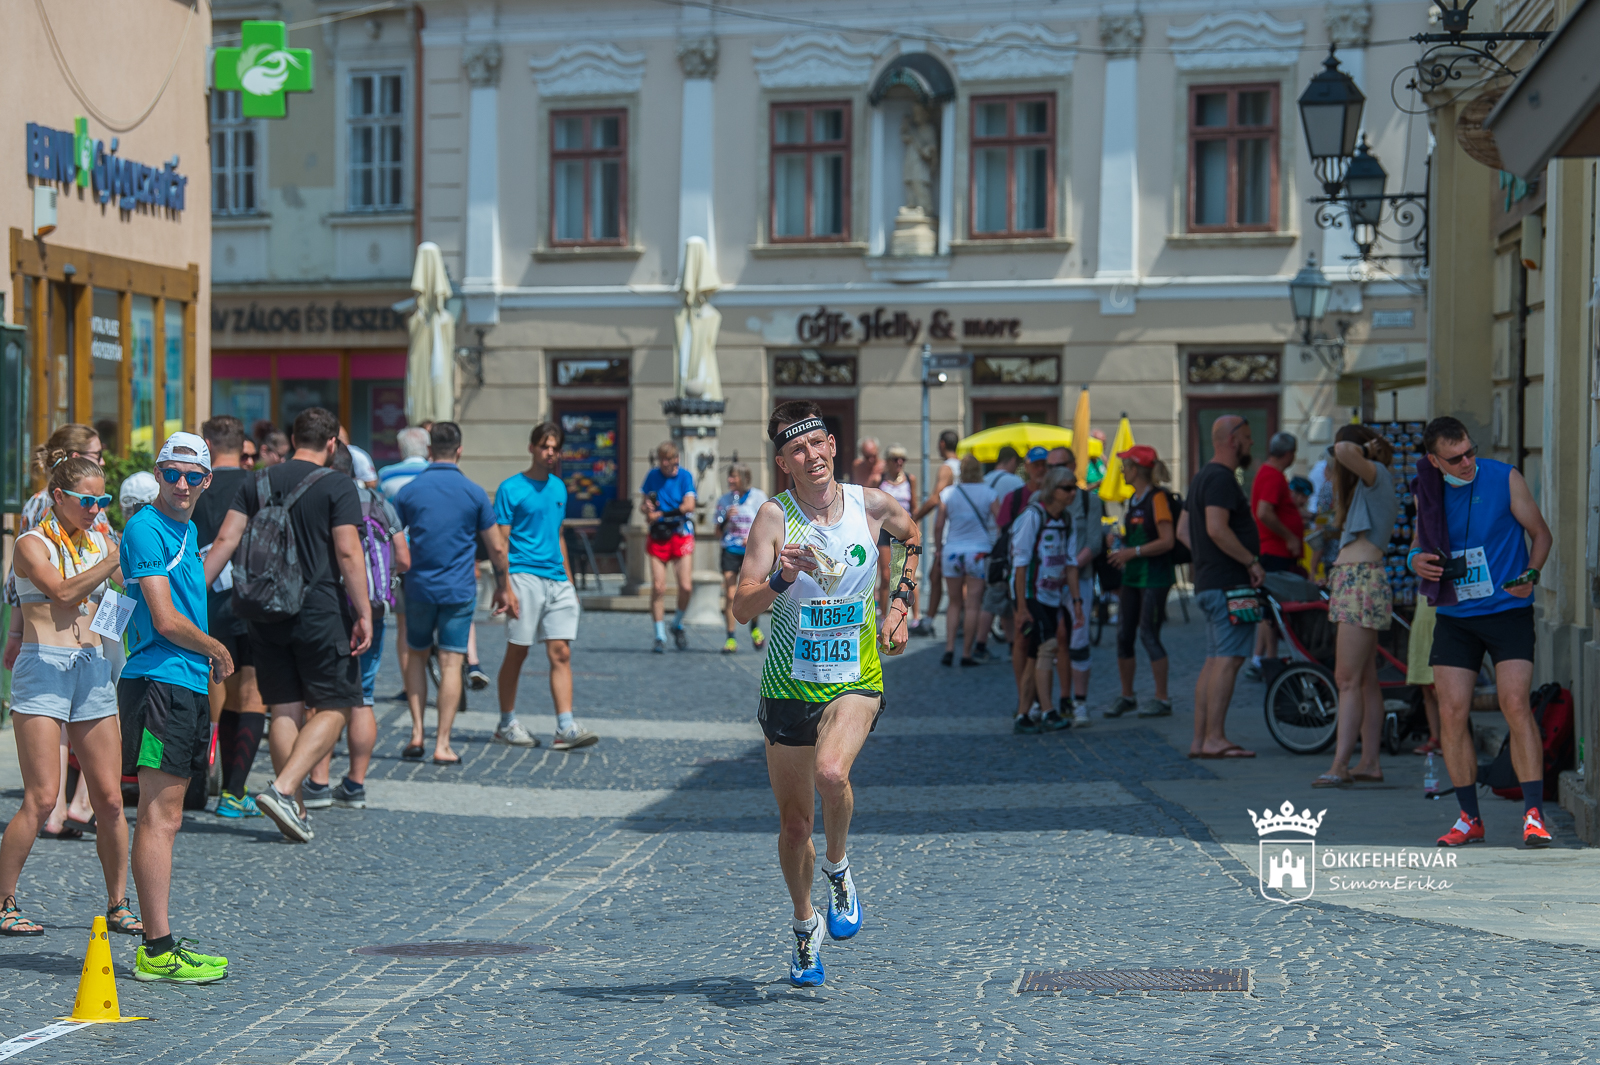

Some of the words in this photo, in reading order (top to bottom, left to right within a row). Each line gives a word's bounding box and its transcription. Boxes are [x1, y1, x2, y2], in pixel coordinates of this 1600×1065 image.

[232, 301, 301, 333] ZÁLOG
[304, 301, 328, 333] ÉS
[929, 309, 956, 341] &
[963, 318, 1021, 338] more
[137, 561, 161, 570] STAFF
[811, 605, 855, 627] M35-2
[801, 639, 851, 662] 35143
